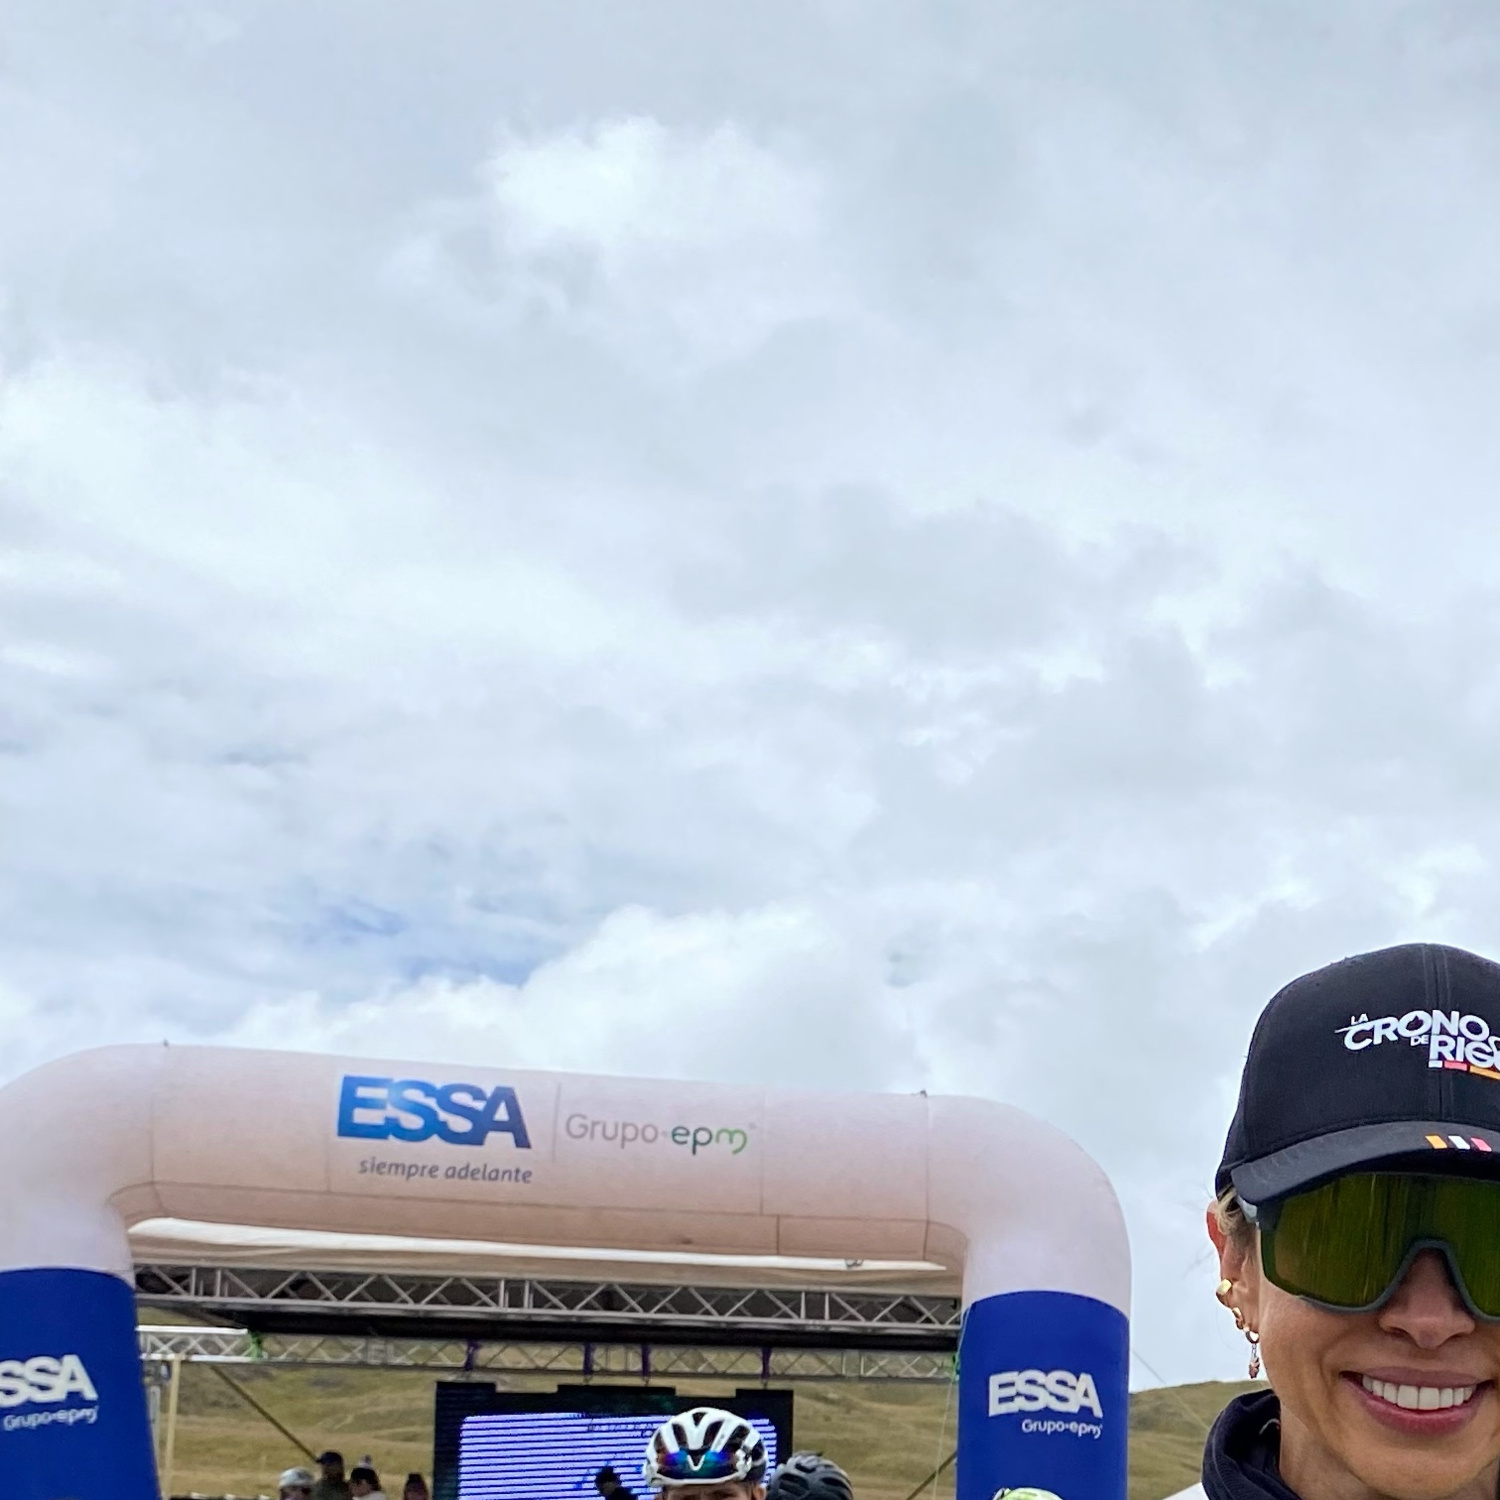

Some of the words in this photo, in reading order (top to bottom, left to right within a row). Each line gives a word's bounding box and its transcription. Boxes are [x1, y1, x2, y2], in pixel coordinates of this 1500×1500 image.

[1335, 1009, 1490, 1051] CRONO
[1351, 1013, 1368, 1025] LA
[1410, 1034, 1429, 1047] DE
[337, 1074, 532, 1149] ESSA
[359, 1156, 439, 1181] siempre
[444, 1162, 532, 1184] adelante
[988, 1369, 1103, 1418] ESSA
